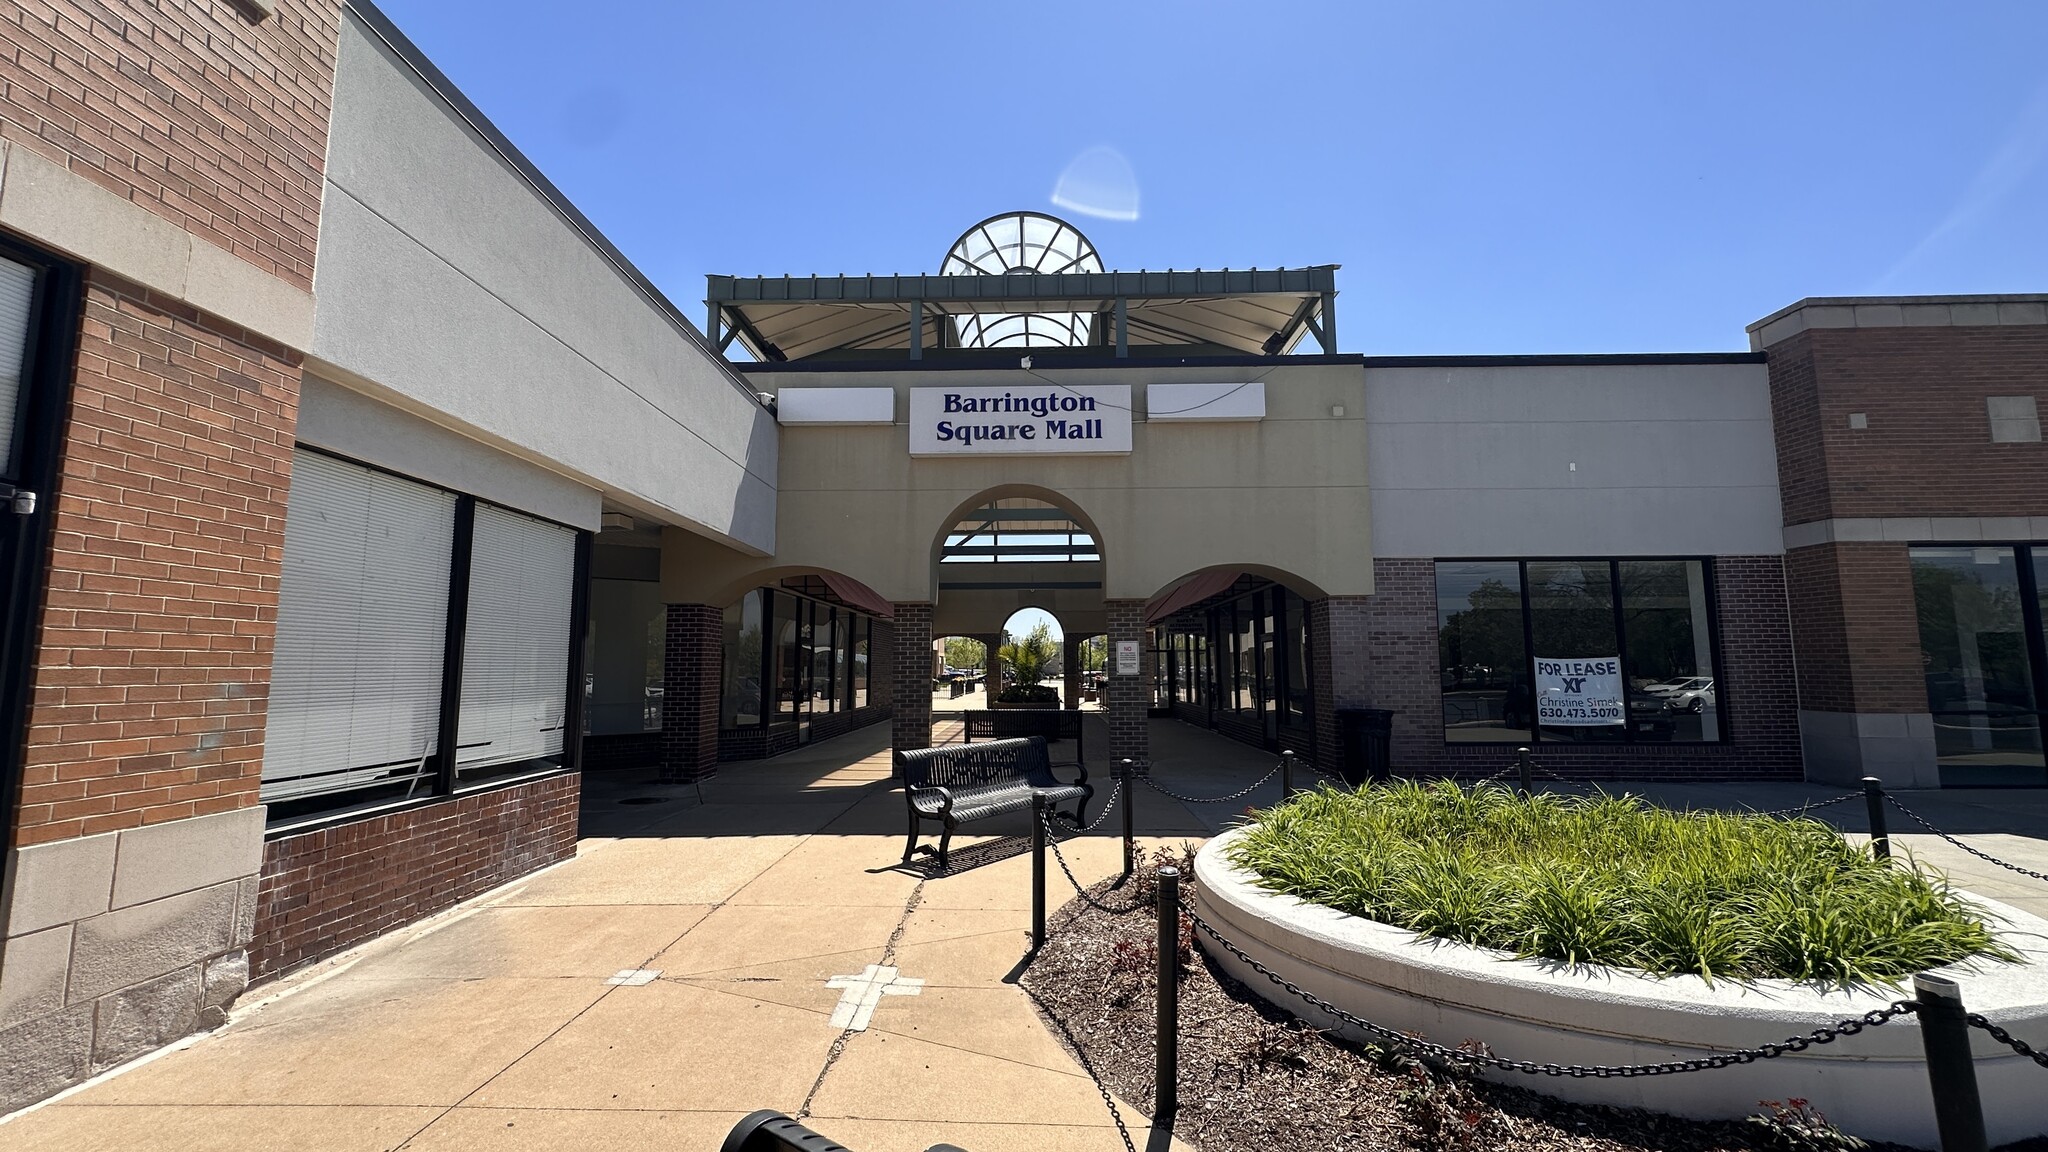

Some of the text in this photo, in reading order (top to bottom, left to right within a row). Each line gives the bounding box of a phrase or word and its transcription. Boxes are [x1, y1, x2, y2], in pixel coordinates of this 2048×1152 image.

[943, 392, 1096, 418] Barrington
[936, 419, 1103, 446] Square Mall
[1538, 661, 1617, 676] FOR LEASE
[1539, 696, 1618, 708] Christine Simek
[1540, 707, 1619, 718] 630.473.5070
